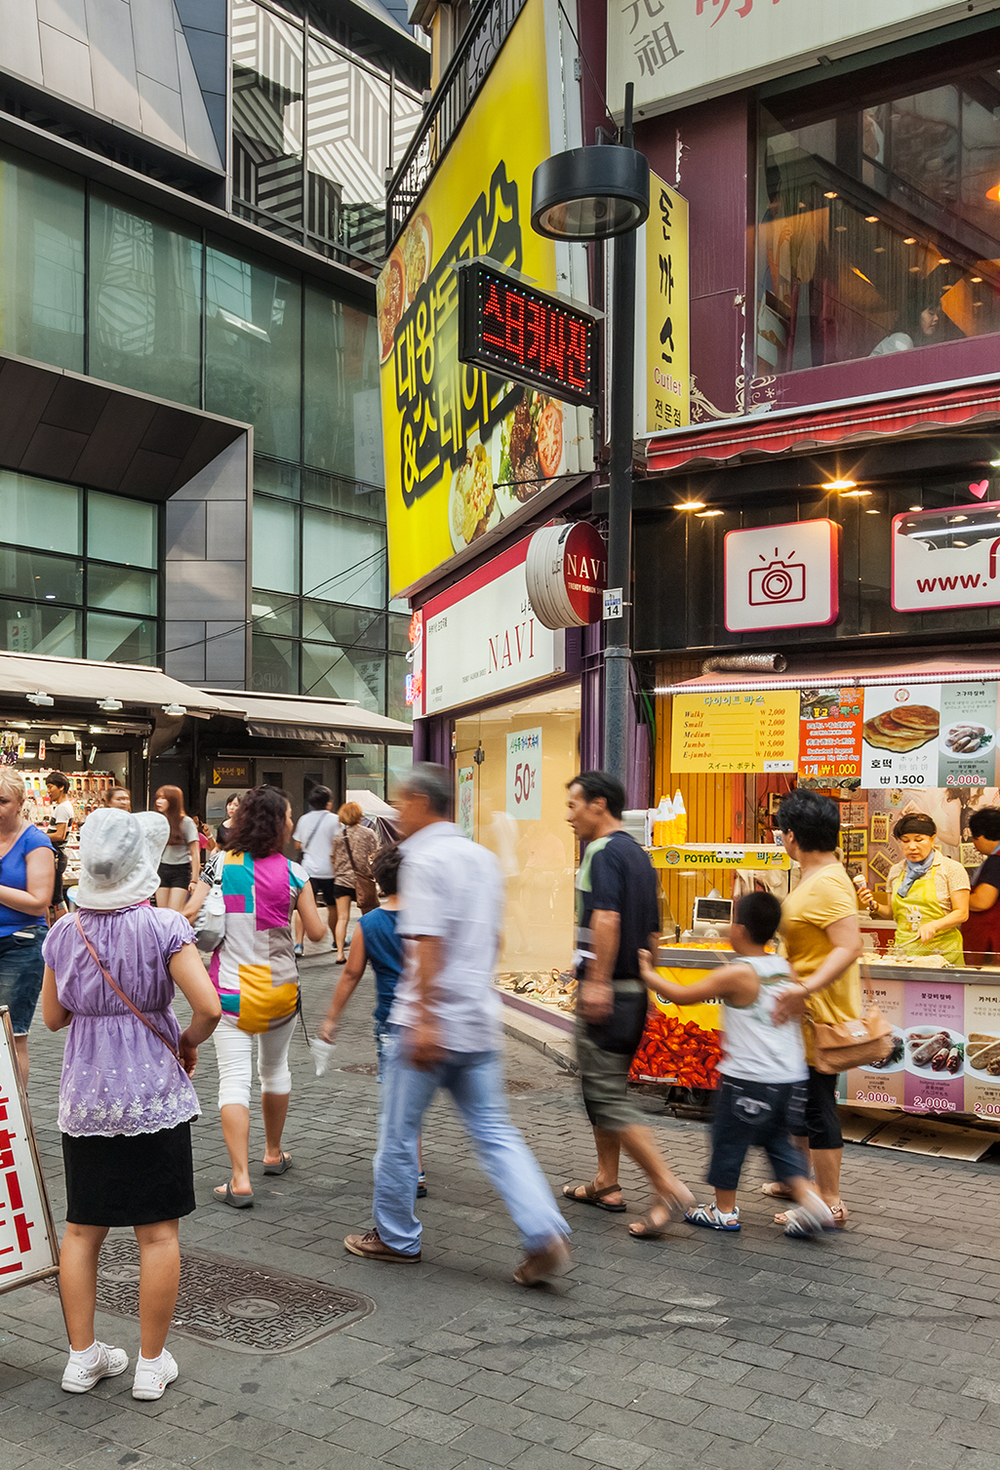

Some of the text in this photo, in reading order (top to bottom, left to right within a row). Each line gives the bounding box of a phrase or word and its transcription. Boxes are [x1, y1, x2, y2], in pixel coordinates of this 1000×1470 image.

[653, 366, 683, 398] Cutlet
[654, 397, 682, 429] 전문점
[403, 367, 505, 495] &스테이
[566, 553, 607, 583] NAVI
[607, 605, 620, 617] 14
[488, 618, 535, 674] NAVI
[684, 711, 705, 719] Walky
[768, 708, 786, 716] 2,000
[768, 719, 785, 727] 2,000
[767, 729, 785, 737] 3,000
[683, 741, 706, 749] Jumbo
[682, 751, 712, 760] E-jumbo
[763, 750, 785, 758] 10,000
[804, 763, 819, 775] 1개
[871, 758, 892, 769] 호떡
[514, 763, 537, 805] 50%
